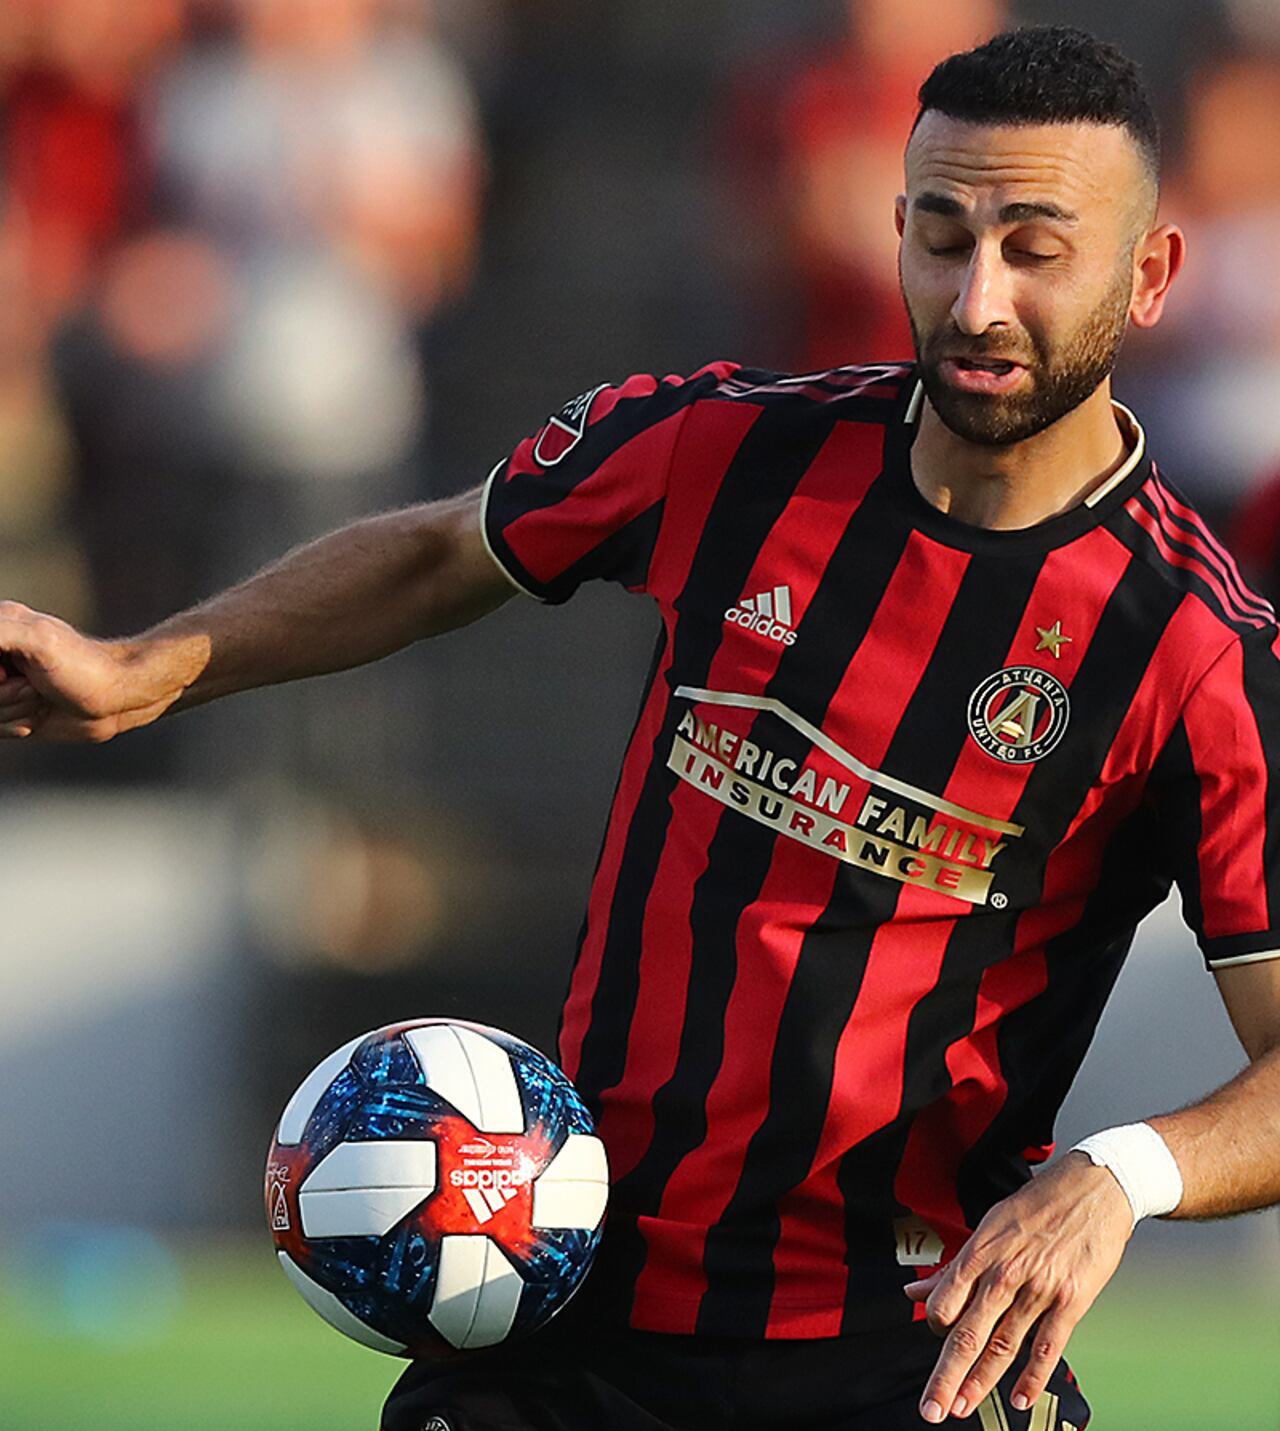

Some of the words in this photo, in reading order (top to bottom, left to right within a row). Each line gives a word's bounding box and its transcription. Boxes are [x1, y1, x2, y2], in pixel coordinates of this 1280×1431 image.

[724, 607, 798, 646] adidas
[1001, 670, 1065, 708] ATLANTA
[972, 717, 1017, 760] UNITED
[1023, 745, 1043, 759] FC
[676, 708, 850, 816] AMERICAN
[856, 794, 1007, 869] FAMILY
[684, 754, 963, 890] INSURANCE
